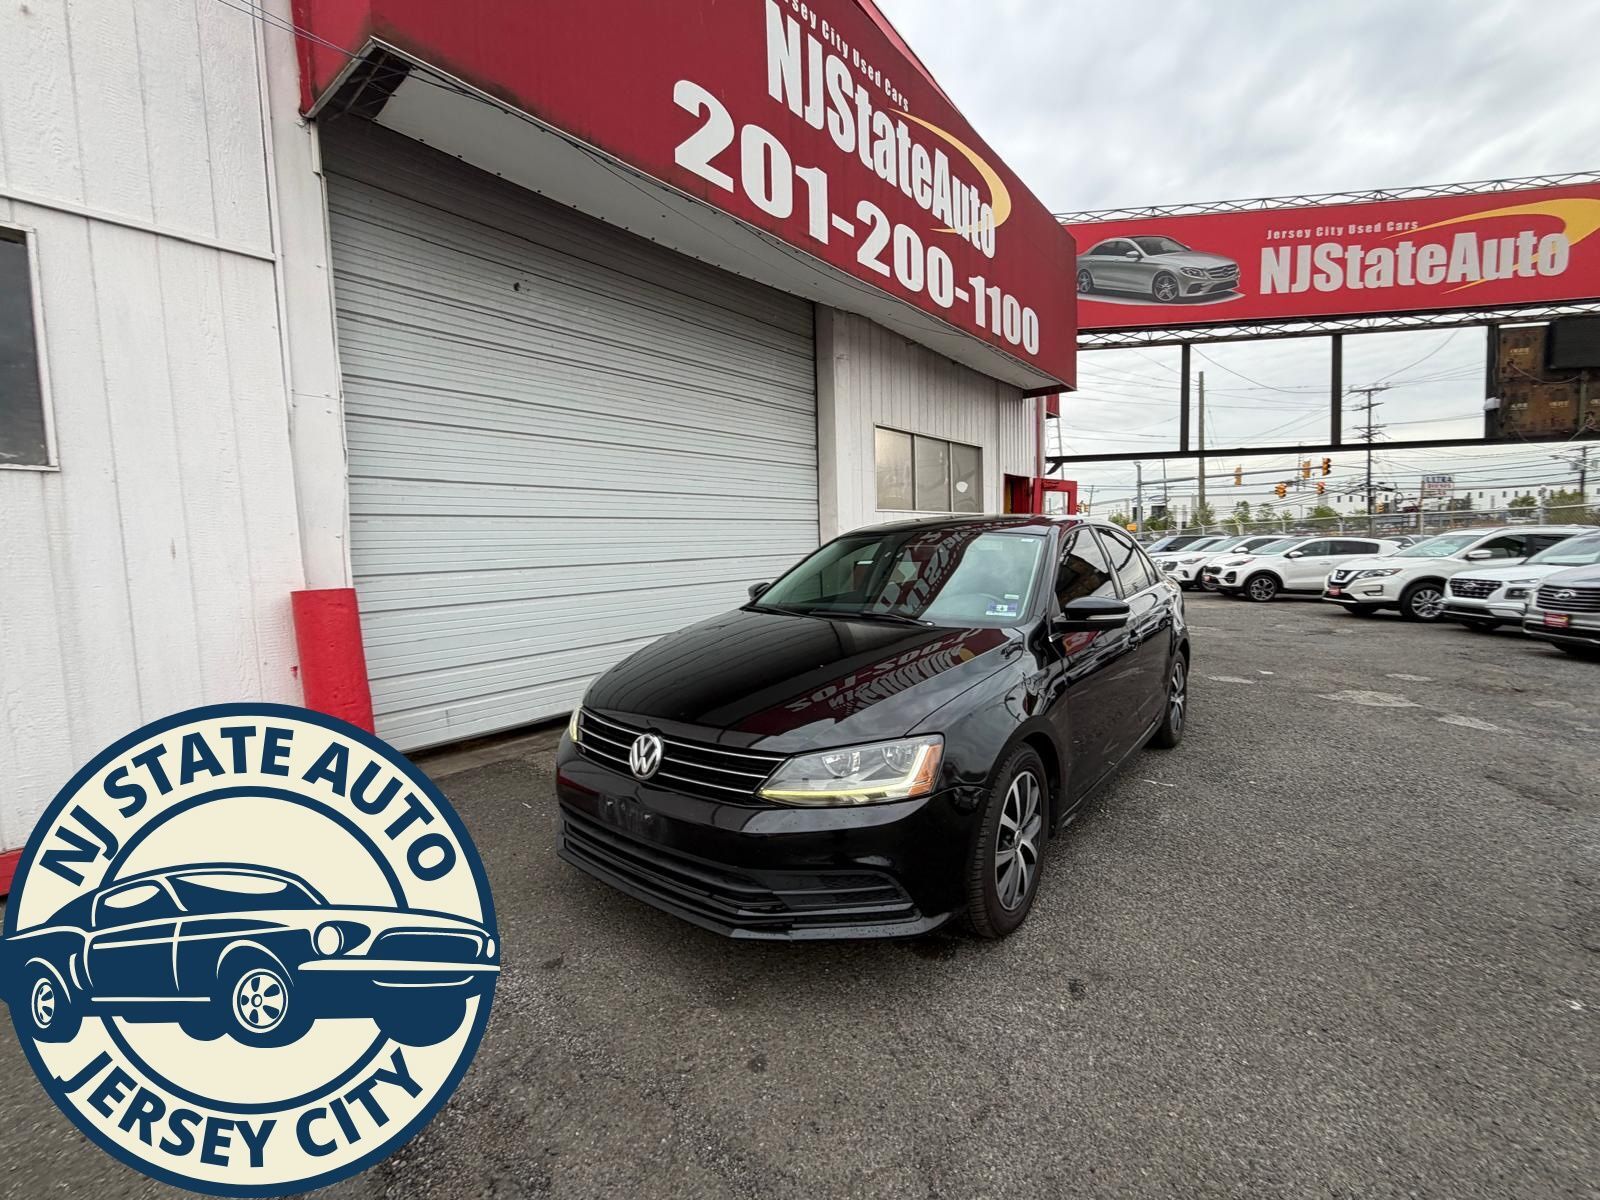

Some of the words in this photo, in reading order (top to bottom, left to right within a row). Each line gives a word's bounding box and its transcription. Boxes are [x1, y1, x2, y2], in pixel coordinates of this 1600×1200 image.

[821, 19, 849, 59] City
[852, 48, 881, 88] Used
[884, 77, 909, 113] Cars
[765, 0, 997, 259] NJStateAuto
[673, 79, 1040, 356] 201-200-1100
[1259, 230, 1571, 295] NJStateAuto
[1266, 229, 1311, 241] Jersey
[1315, 226, 1344, 238] City
[1348, 223, 1382, 235] Used
[1386, 220, 1419, 232] Cars
